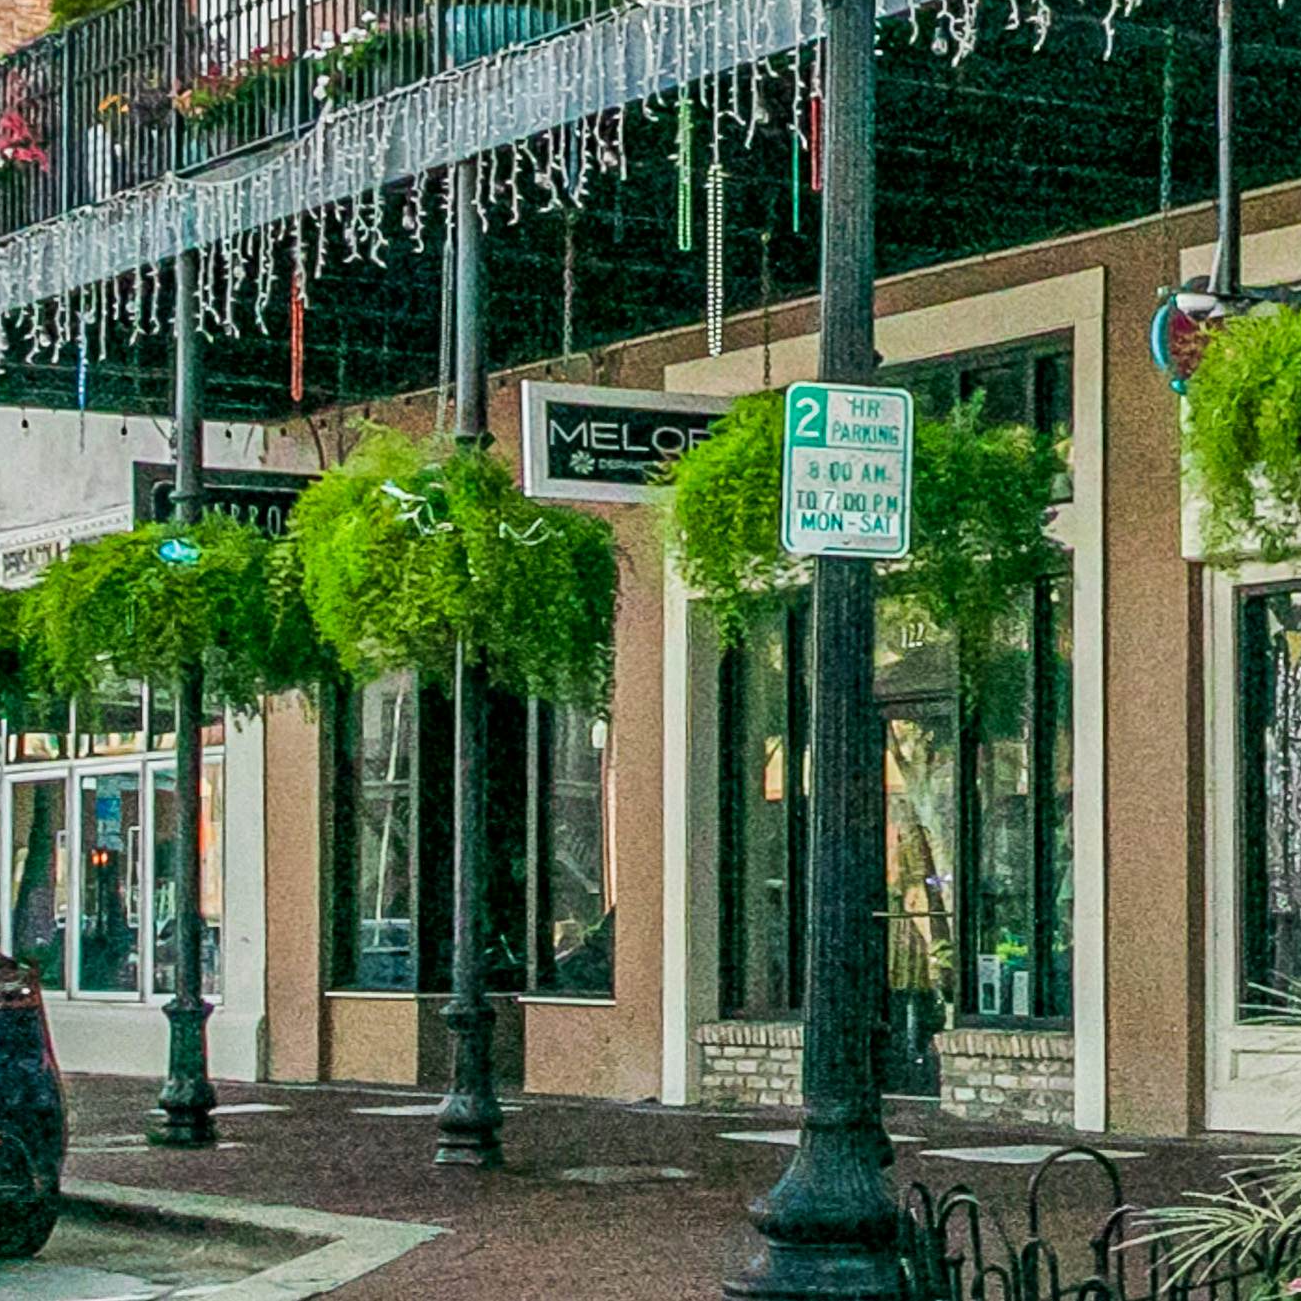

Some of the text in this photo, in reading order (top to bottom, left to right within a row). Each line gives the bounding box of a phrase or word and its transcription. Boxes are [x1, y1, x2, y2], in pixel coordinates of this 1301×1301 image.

[796, 397, 881, 438] 2 HR
[832, 421, 900, 445] PARKING
[796, 490, 817, 510] TO
[824, 491, 866, 512] 7:00
